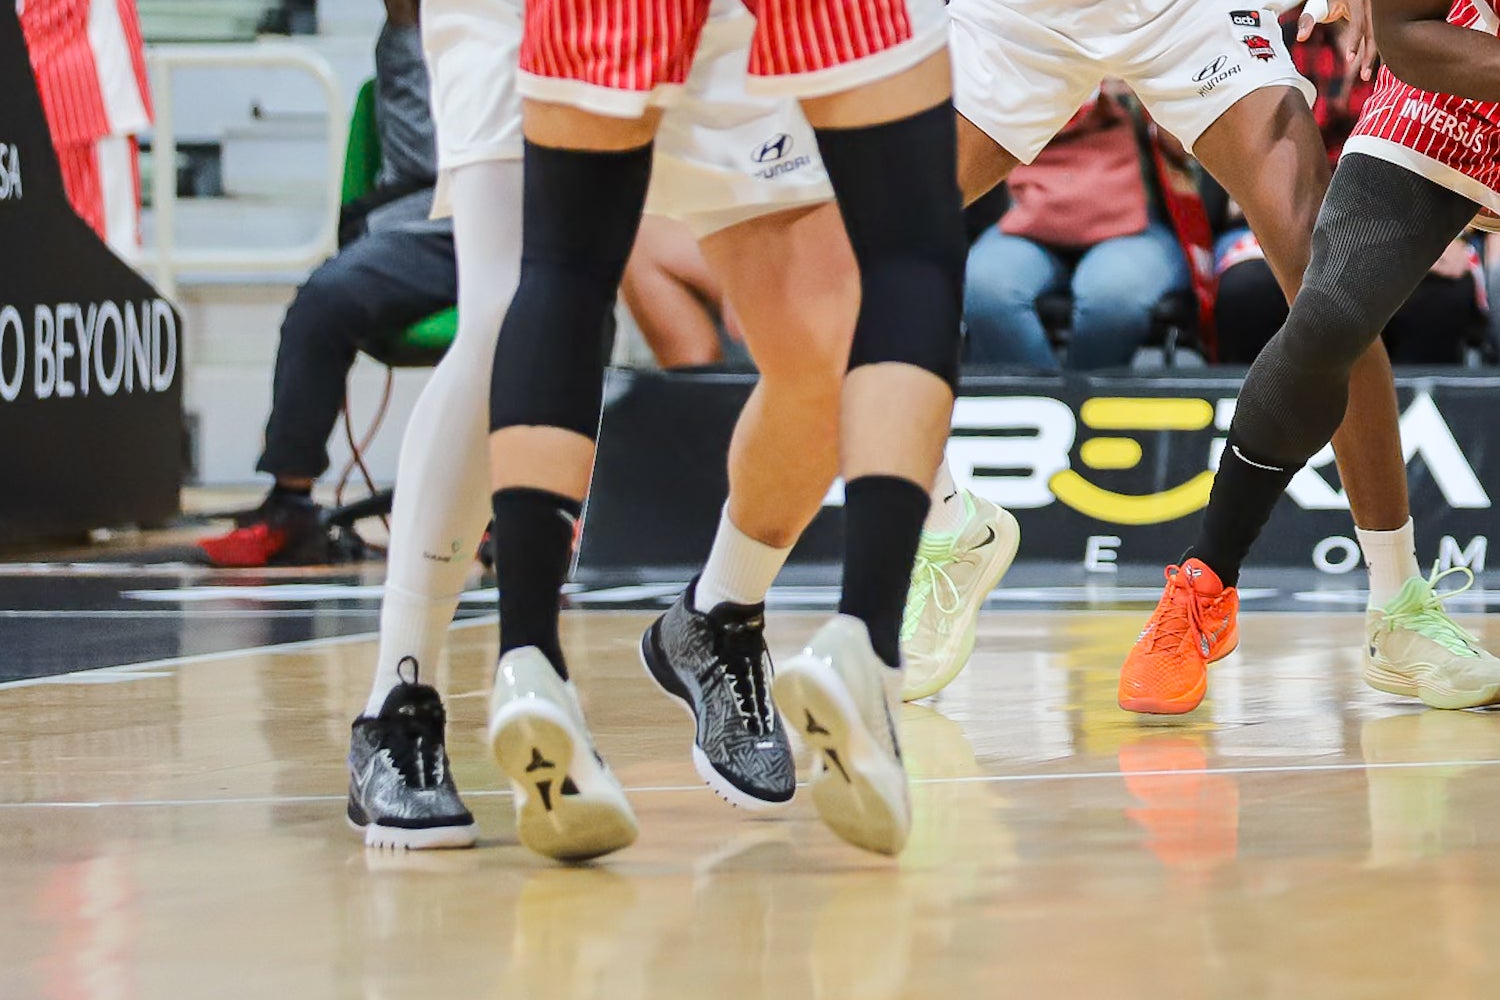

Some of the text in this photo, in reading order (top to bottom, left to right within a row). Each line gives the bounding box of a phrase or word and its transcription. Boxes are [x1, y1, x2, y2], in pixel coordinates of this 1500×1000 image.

[1233, 15, 1256, 26] acb
[1400, 97, 1484, 154] INVERSUS
[34, 299, 177, 400] BEYOND
